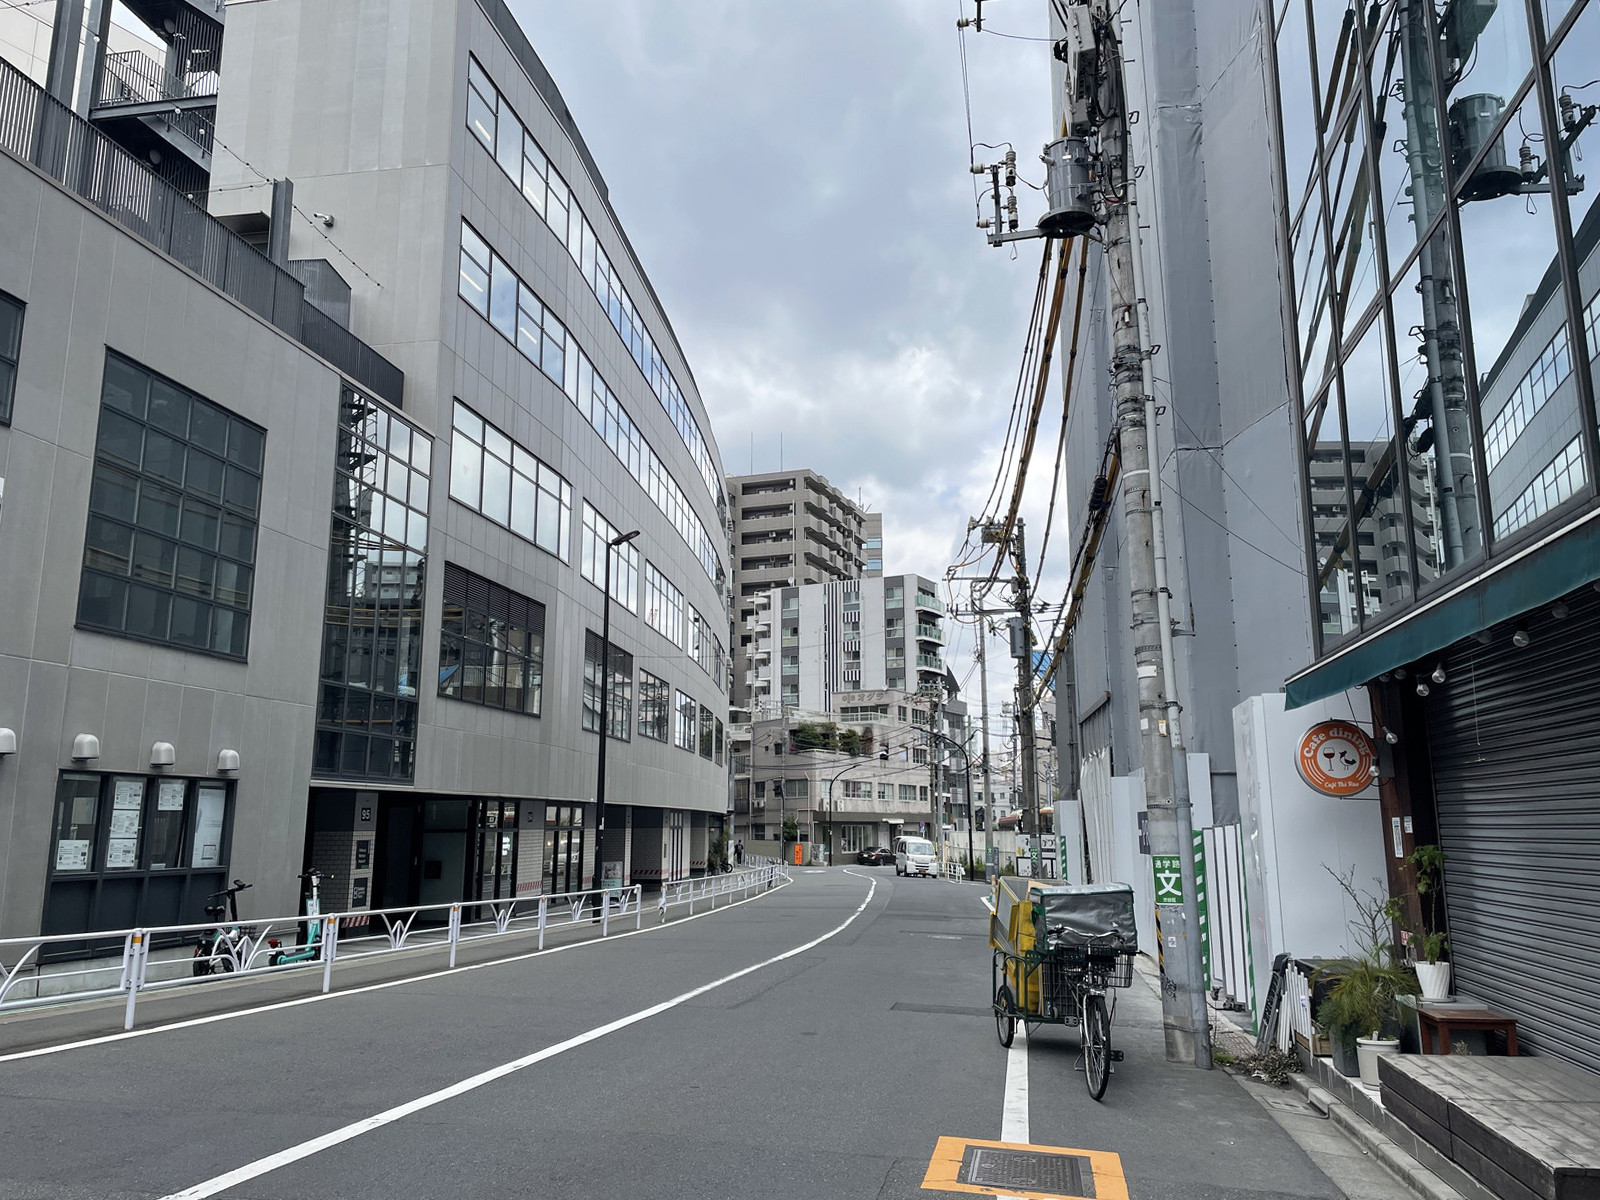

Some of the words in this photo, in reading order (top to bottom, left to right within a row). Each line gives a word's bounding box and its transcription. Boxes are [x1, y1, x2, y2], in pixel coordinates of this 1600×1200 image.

[1329, 727, 1369, 755] dining
[1154, 860, 1181, 869] 通学路
[1156, 869, 1182, 896] 文
